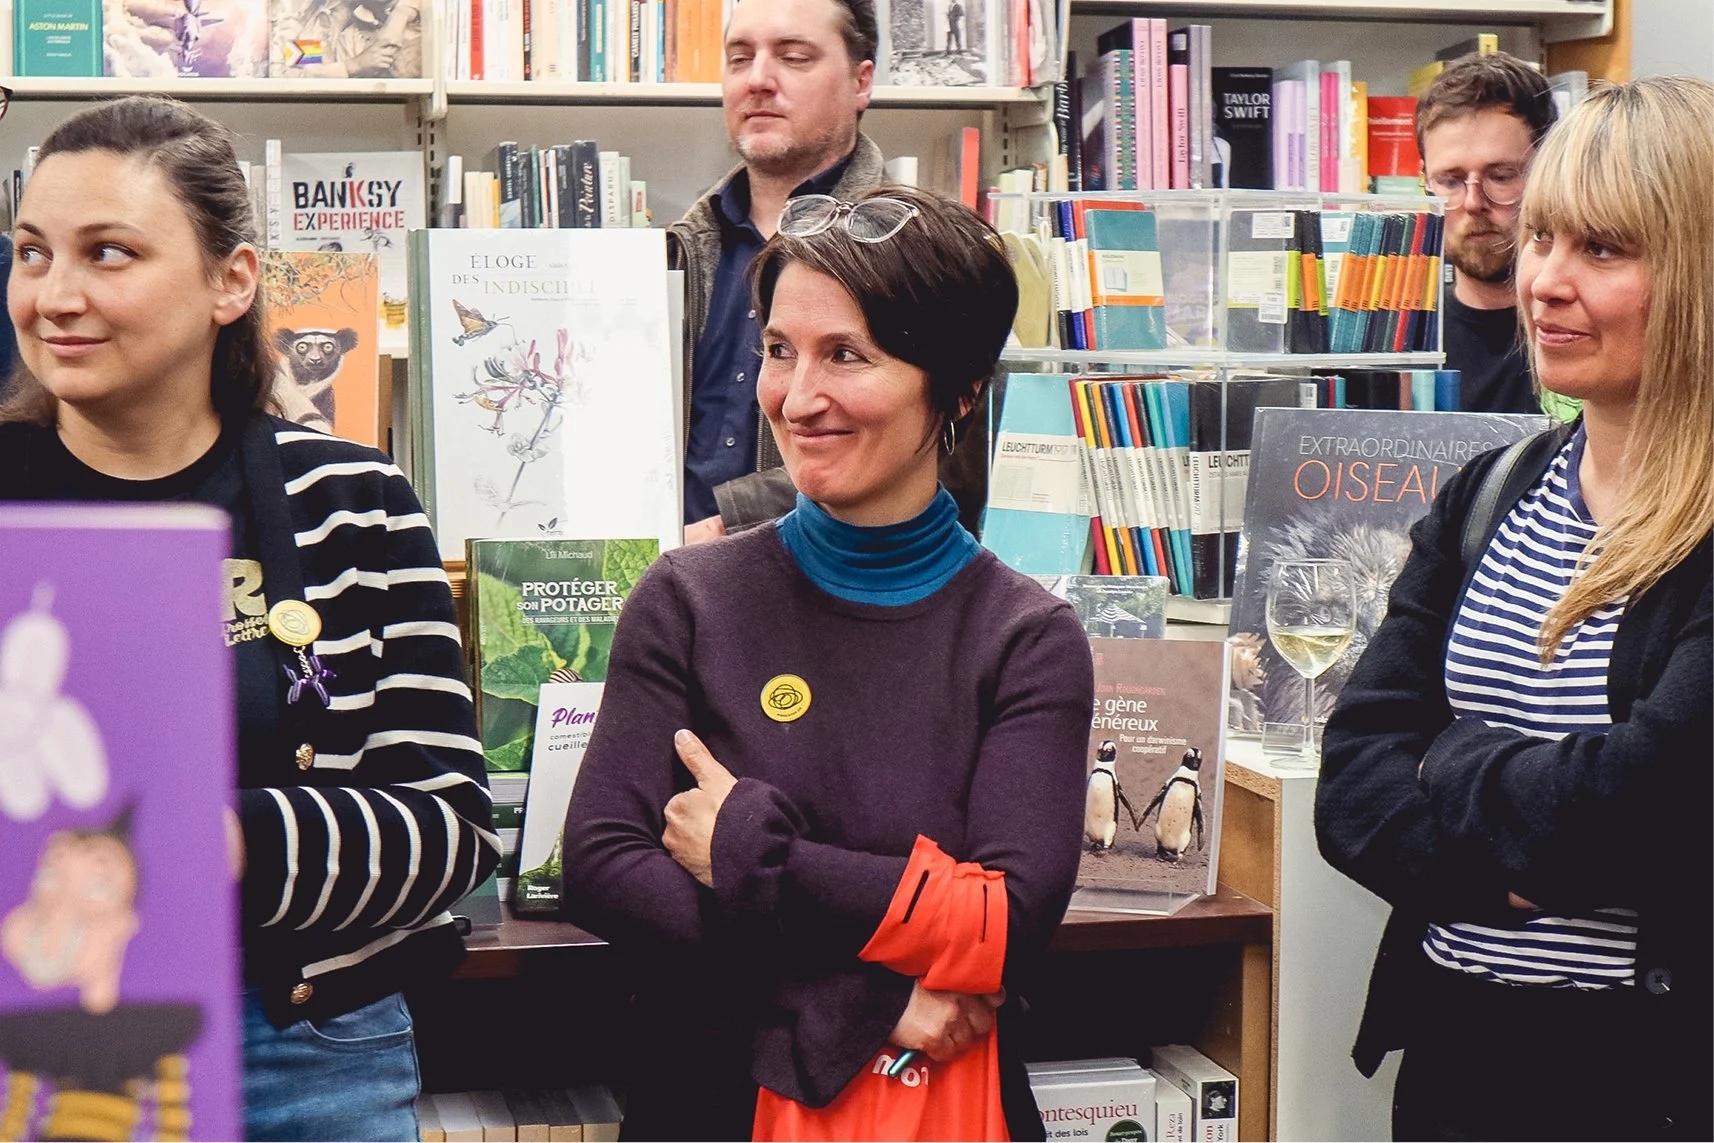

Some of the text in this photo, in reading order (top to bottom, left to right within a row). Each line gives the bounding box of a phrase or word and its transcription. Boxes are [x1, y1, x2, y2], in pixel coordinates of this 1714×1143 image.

[1223, 93, 1270, 105] TAYLOR
[1224, 106, 1270, 118] SWIFT
[293, 180, 402, 209] BANKSY
[293, 211, 404, 231] EXPERIENCE
[471, 253, 537, 269] ÉLOGE
[452, 274, 480, 285] DES
[1299, 436, 1494, 461] EXTRAORDINAIRES
[558, 551, 593, 559] Michaud
[522, 576, 618, 597] PROTÉGER
[517, 596, 625, 613] SON POTAGER
[522, 616, 534, 624] DES
[1105, 696, 1147, 716] gène
[551, 707, 597, 728] Plan
[1119, 734, 1135, 743] Pour
[1147, 735, 1187, 746] darwinisme
[1132, 745, 1167, 755] coopératif
[526, 892, 559, 900] Larivière
[527, 885, 551, 893] Roger
[1038, 1099, 1138, 1126] ontesquieu
[1055, 1129, 1071, 1138] des
[1073, 1127, 1089, 1137] lois
[1166, 1113, 1176, 1138] Reza
[1216, 1124, 1224, 1142] York
